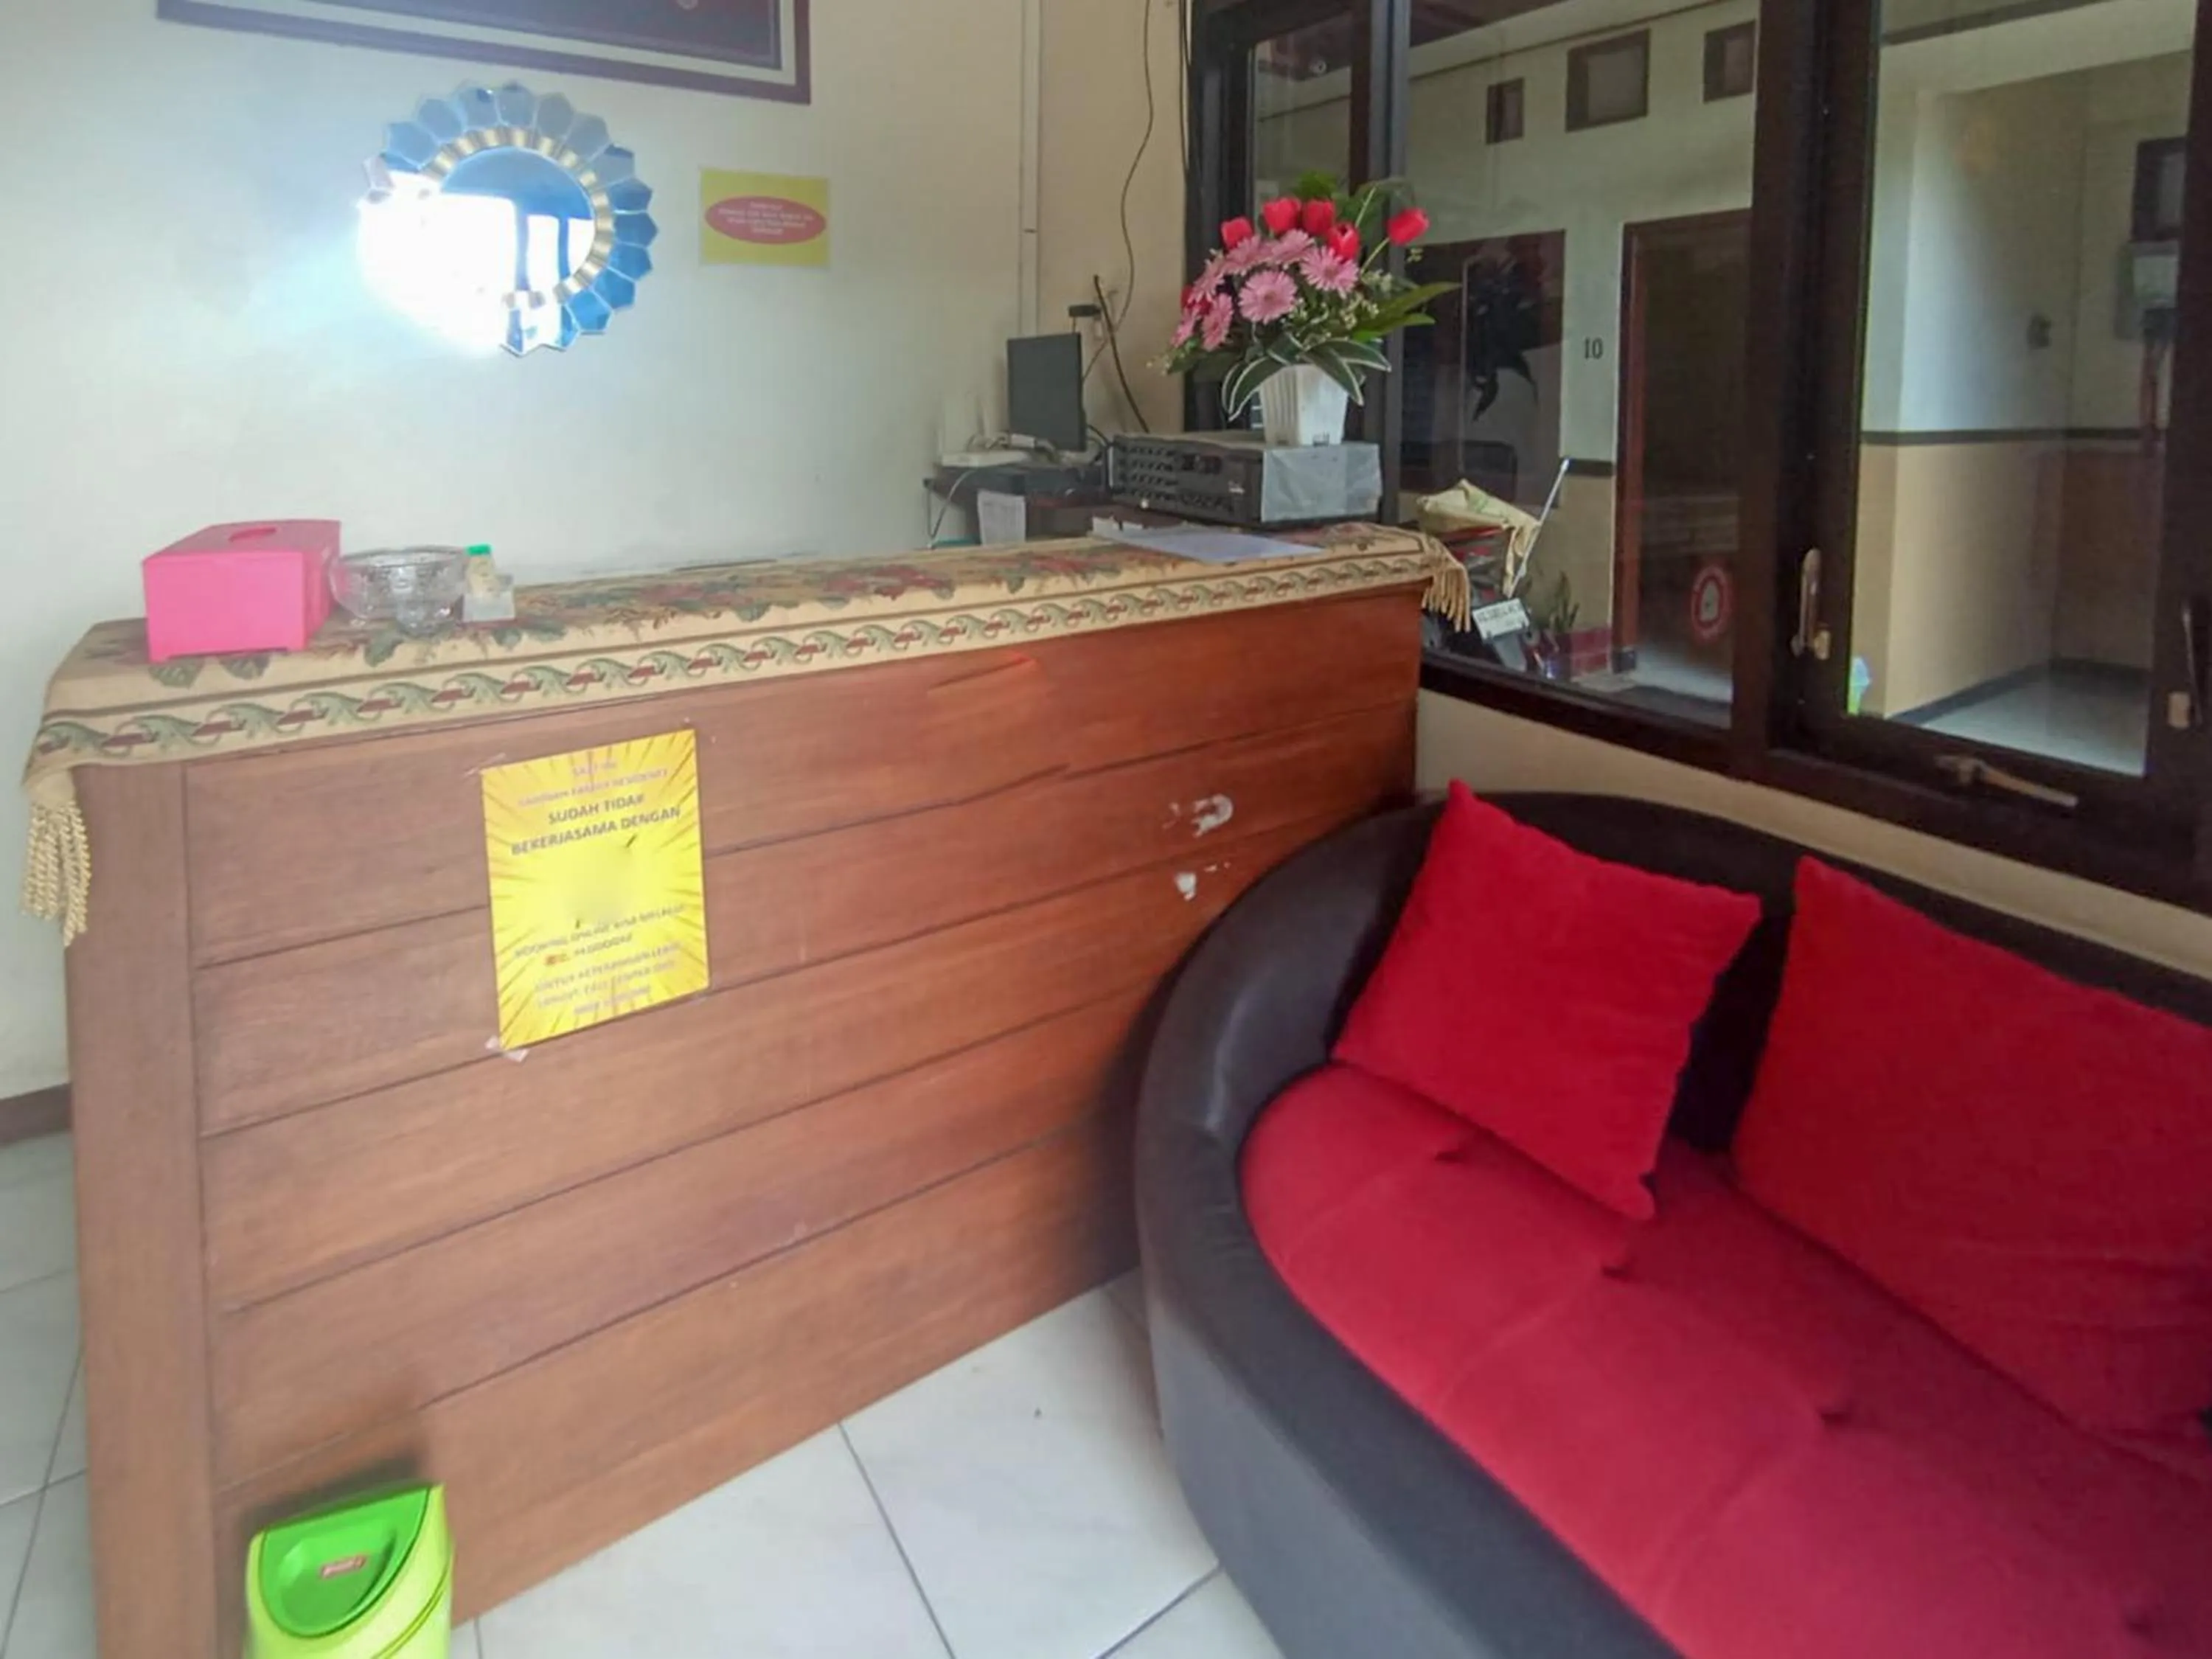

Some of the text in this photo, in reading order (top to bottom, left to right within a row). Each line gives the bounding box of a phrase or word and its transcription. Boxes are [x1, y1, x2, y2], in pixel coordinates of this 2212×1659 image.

[1583, 335, 1604, 361] 10
[549, 793, 645, 824] SUDAH TIDAK
[511, 806, 681, 856] BEKERJASAMA DENGAN
